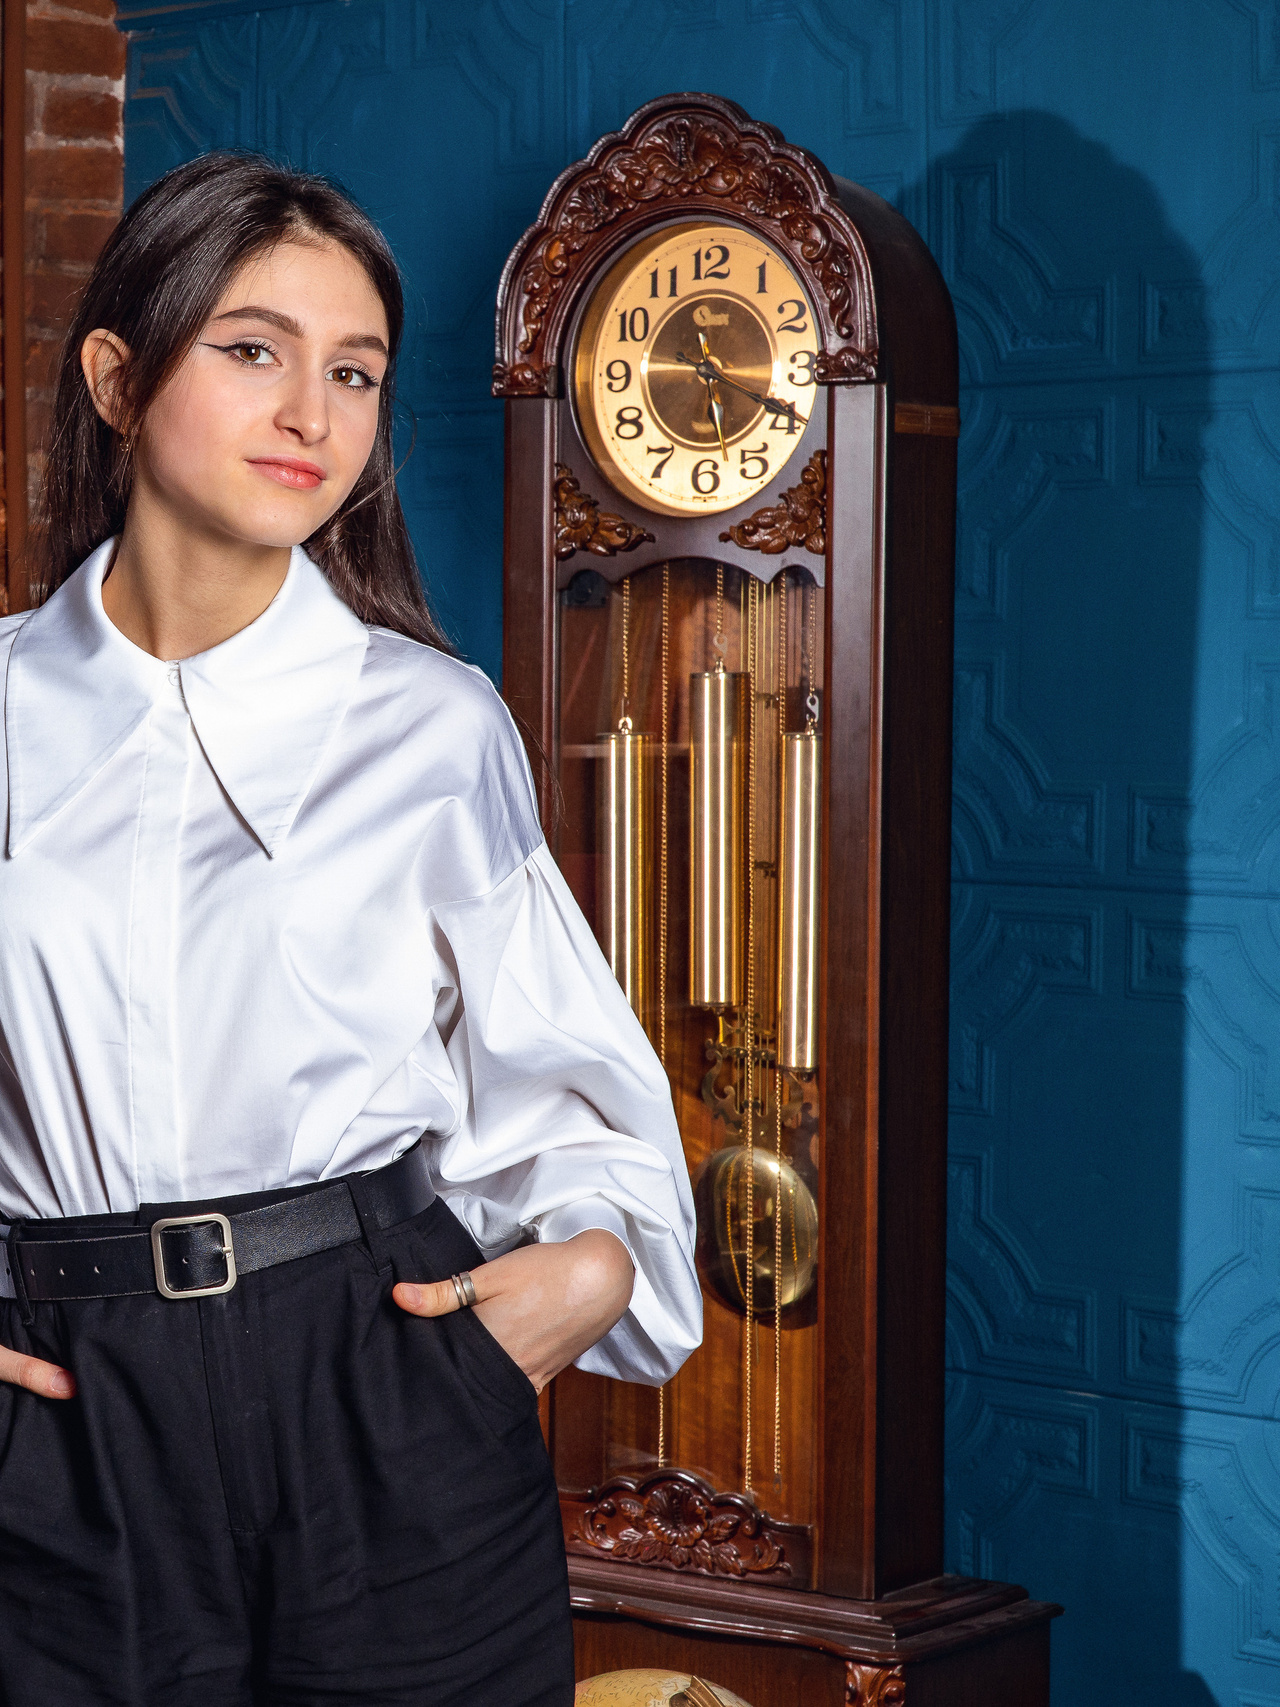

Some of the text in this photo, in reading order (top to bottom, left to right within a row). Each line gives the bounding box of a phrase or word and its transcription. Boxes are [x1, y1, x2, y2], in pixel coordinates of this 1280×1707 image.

[691, 245, 731, 281] 12
[756, 259, 768, 294] 1
[649, 265, 679, 299] 11
[617, 307, 650, 342] 10
[776, 299, 808, 333] 2
[606, 360, 632, 393] 9
[787, 350, 817, 387] 3
[615, 406, 644, 440] 8
[769, 400, 801, 435] 4
[646, 443, 675, 479] 7
[691, 459, 720, 494] 6
[739, 442, 769, 479] 5
